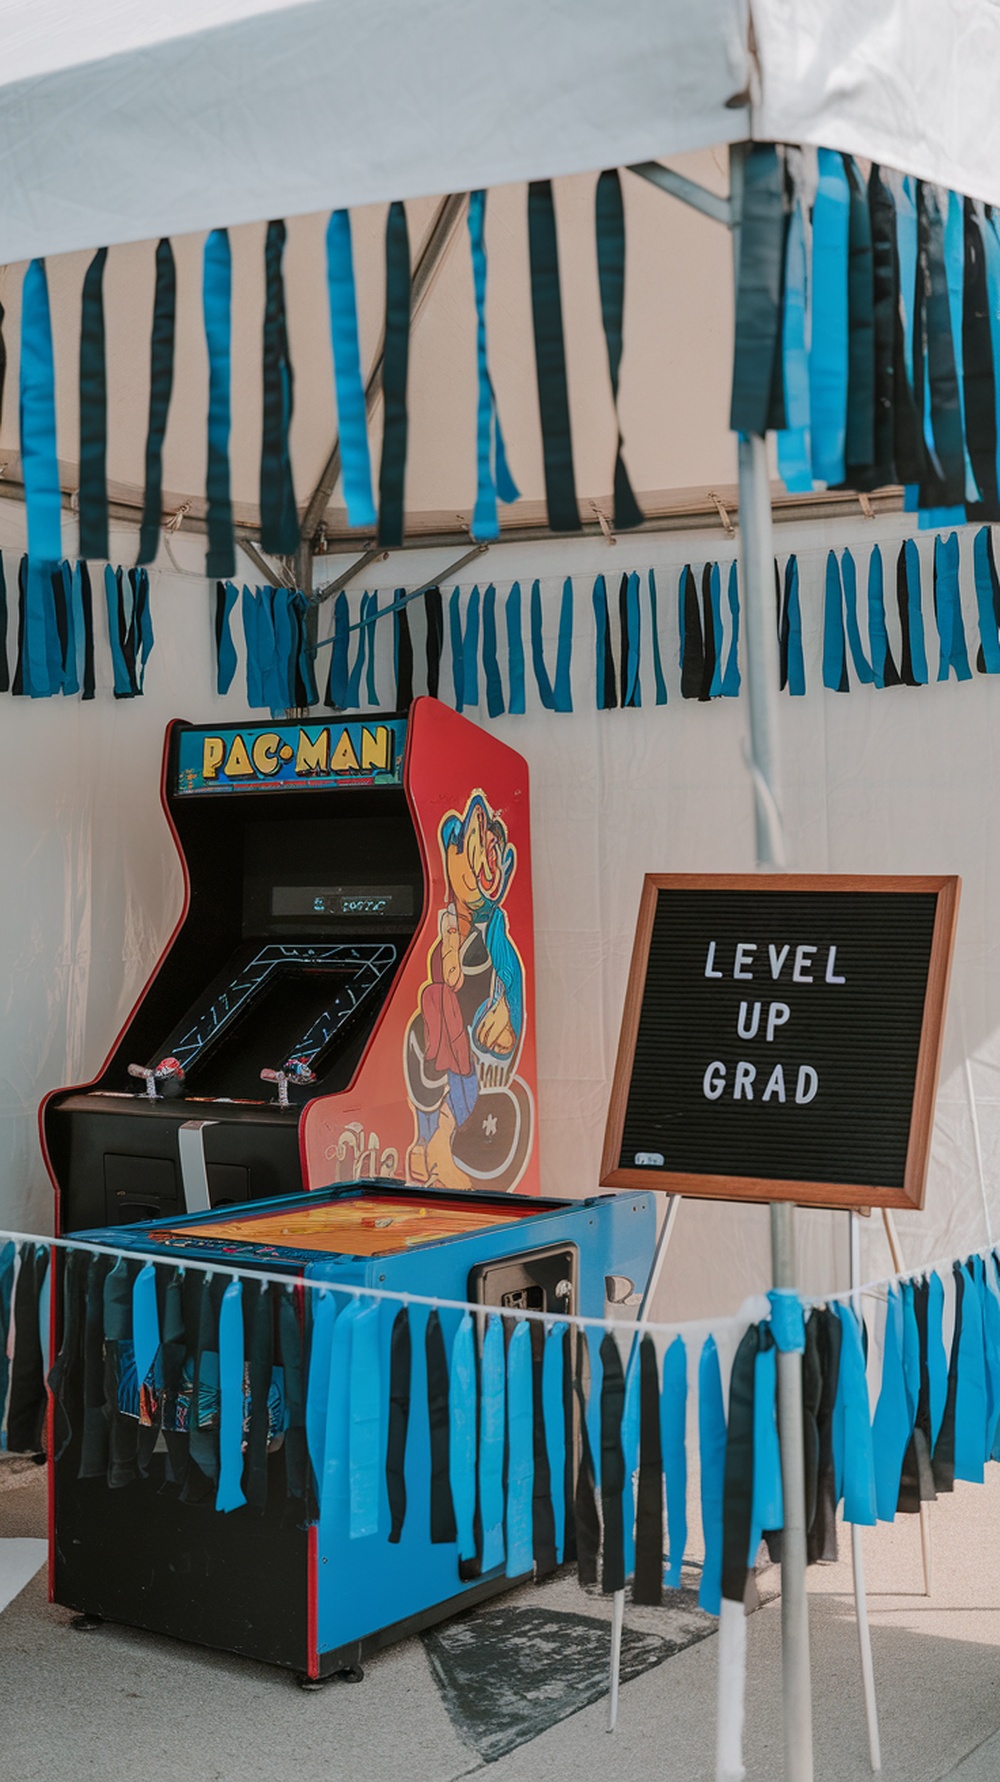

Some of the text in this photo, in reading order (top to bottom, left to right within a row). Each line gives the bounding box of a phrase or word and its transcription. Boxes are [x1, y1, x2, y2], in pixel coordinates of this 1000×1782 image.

[704, 941, 846, 984] LEVEL
[737, 1001, 791, 1042] UP
[703, 1060, 819, 1104] GRAD
